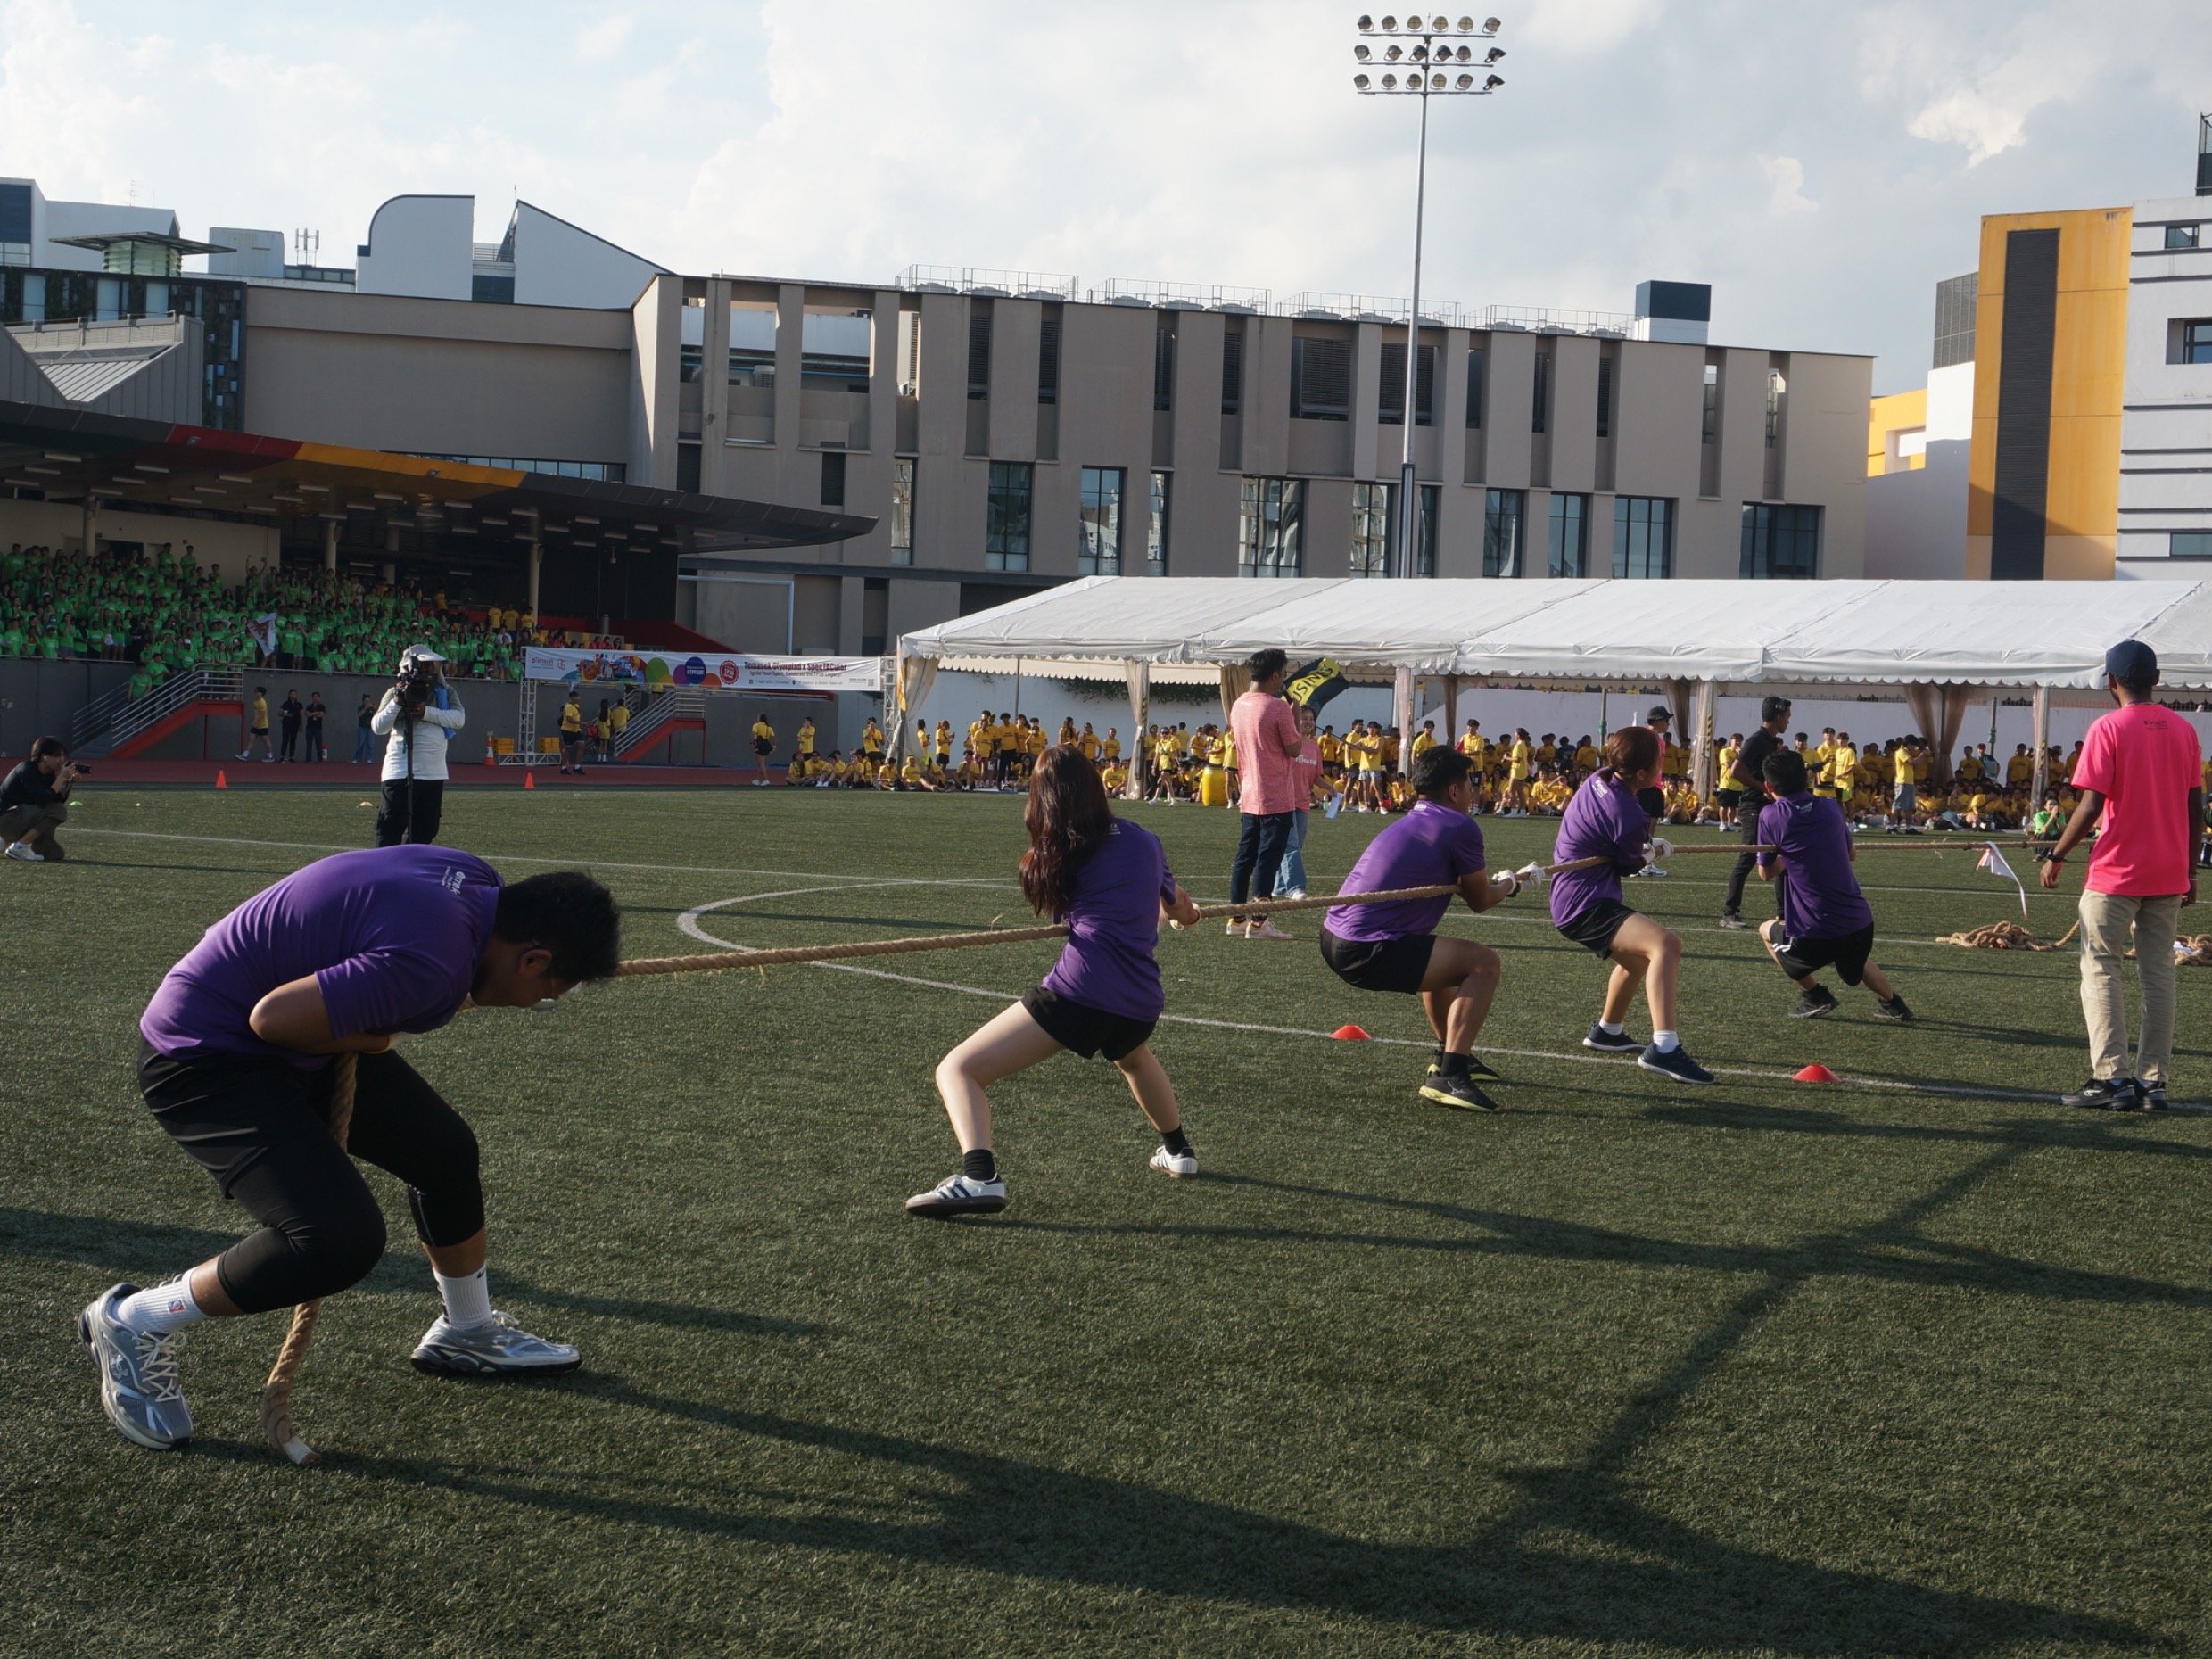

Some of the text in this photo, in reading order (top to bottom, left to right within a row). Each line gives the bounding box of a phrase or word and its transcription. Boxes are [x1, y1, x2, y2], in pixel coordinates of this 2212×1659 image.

[744, 661, 772, 670] Temasek
[772, 662, 802, 671] Olympiad
[807, 663, 847, 671] SpecTACular
